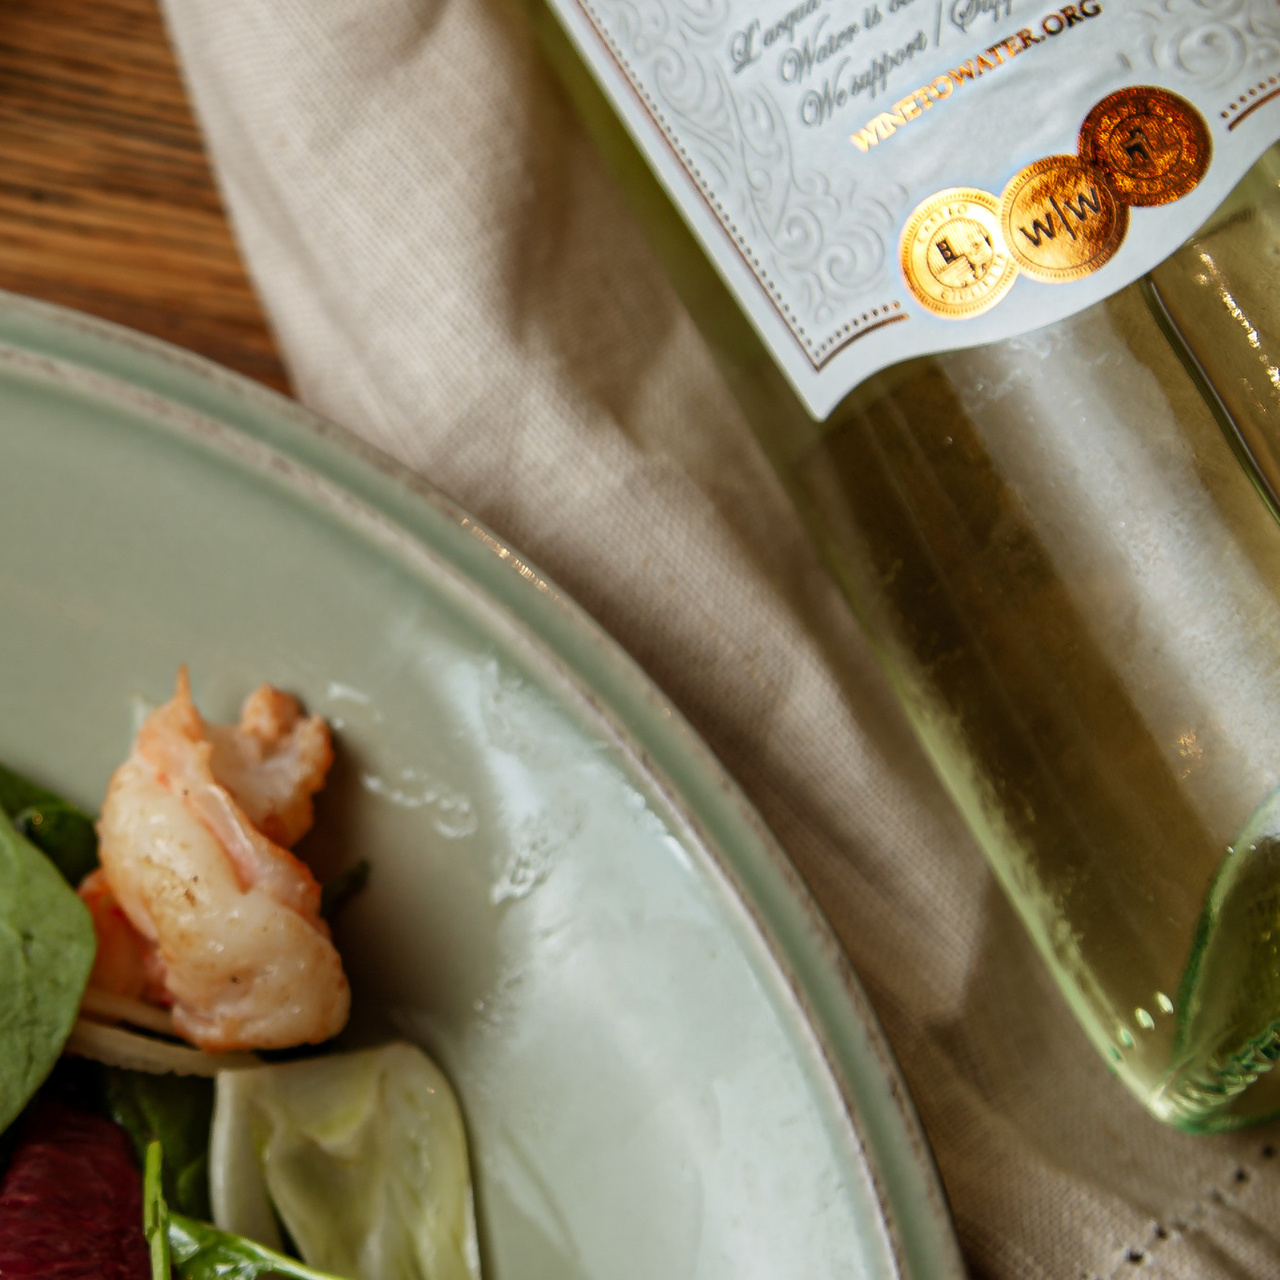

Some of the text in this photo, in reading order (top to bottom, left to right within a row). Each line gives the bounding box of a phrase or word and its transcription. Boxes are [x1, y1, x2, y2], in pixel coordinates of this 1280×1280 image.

[779, 13, 860, 83] Water
[864, 4, 883, 31] is
[800, 56, 851, 126] We
[851, 29, 928, 99] support
